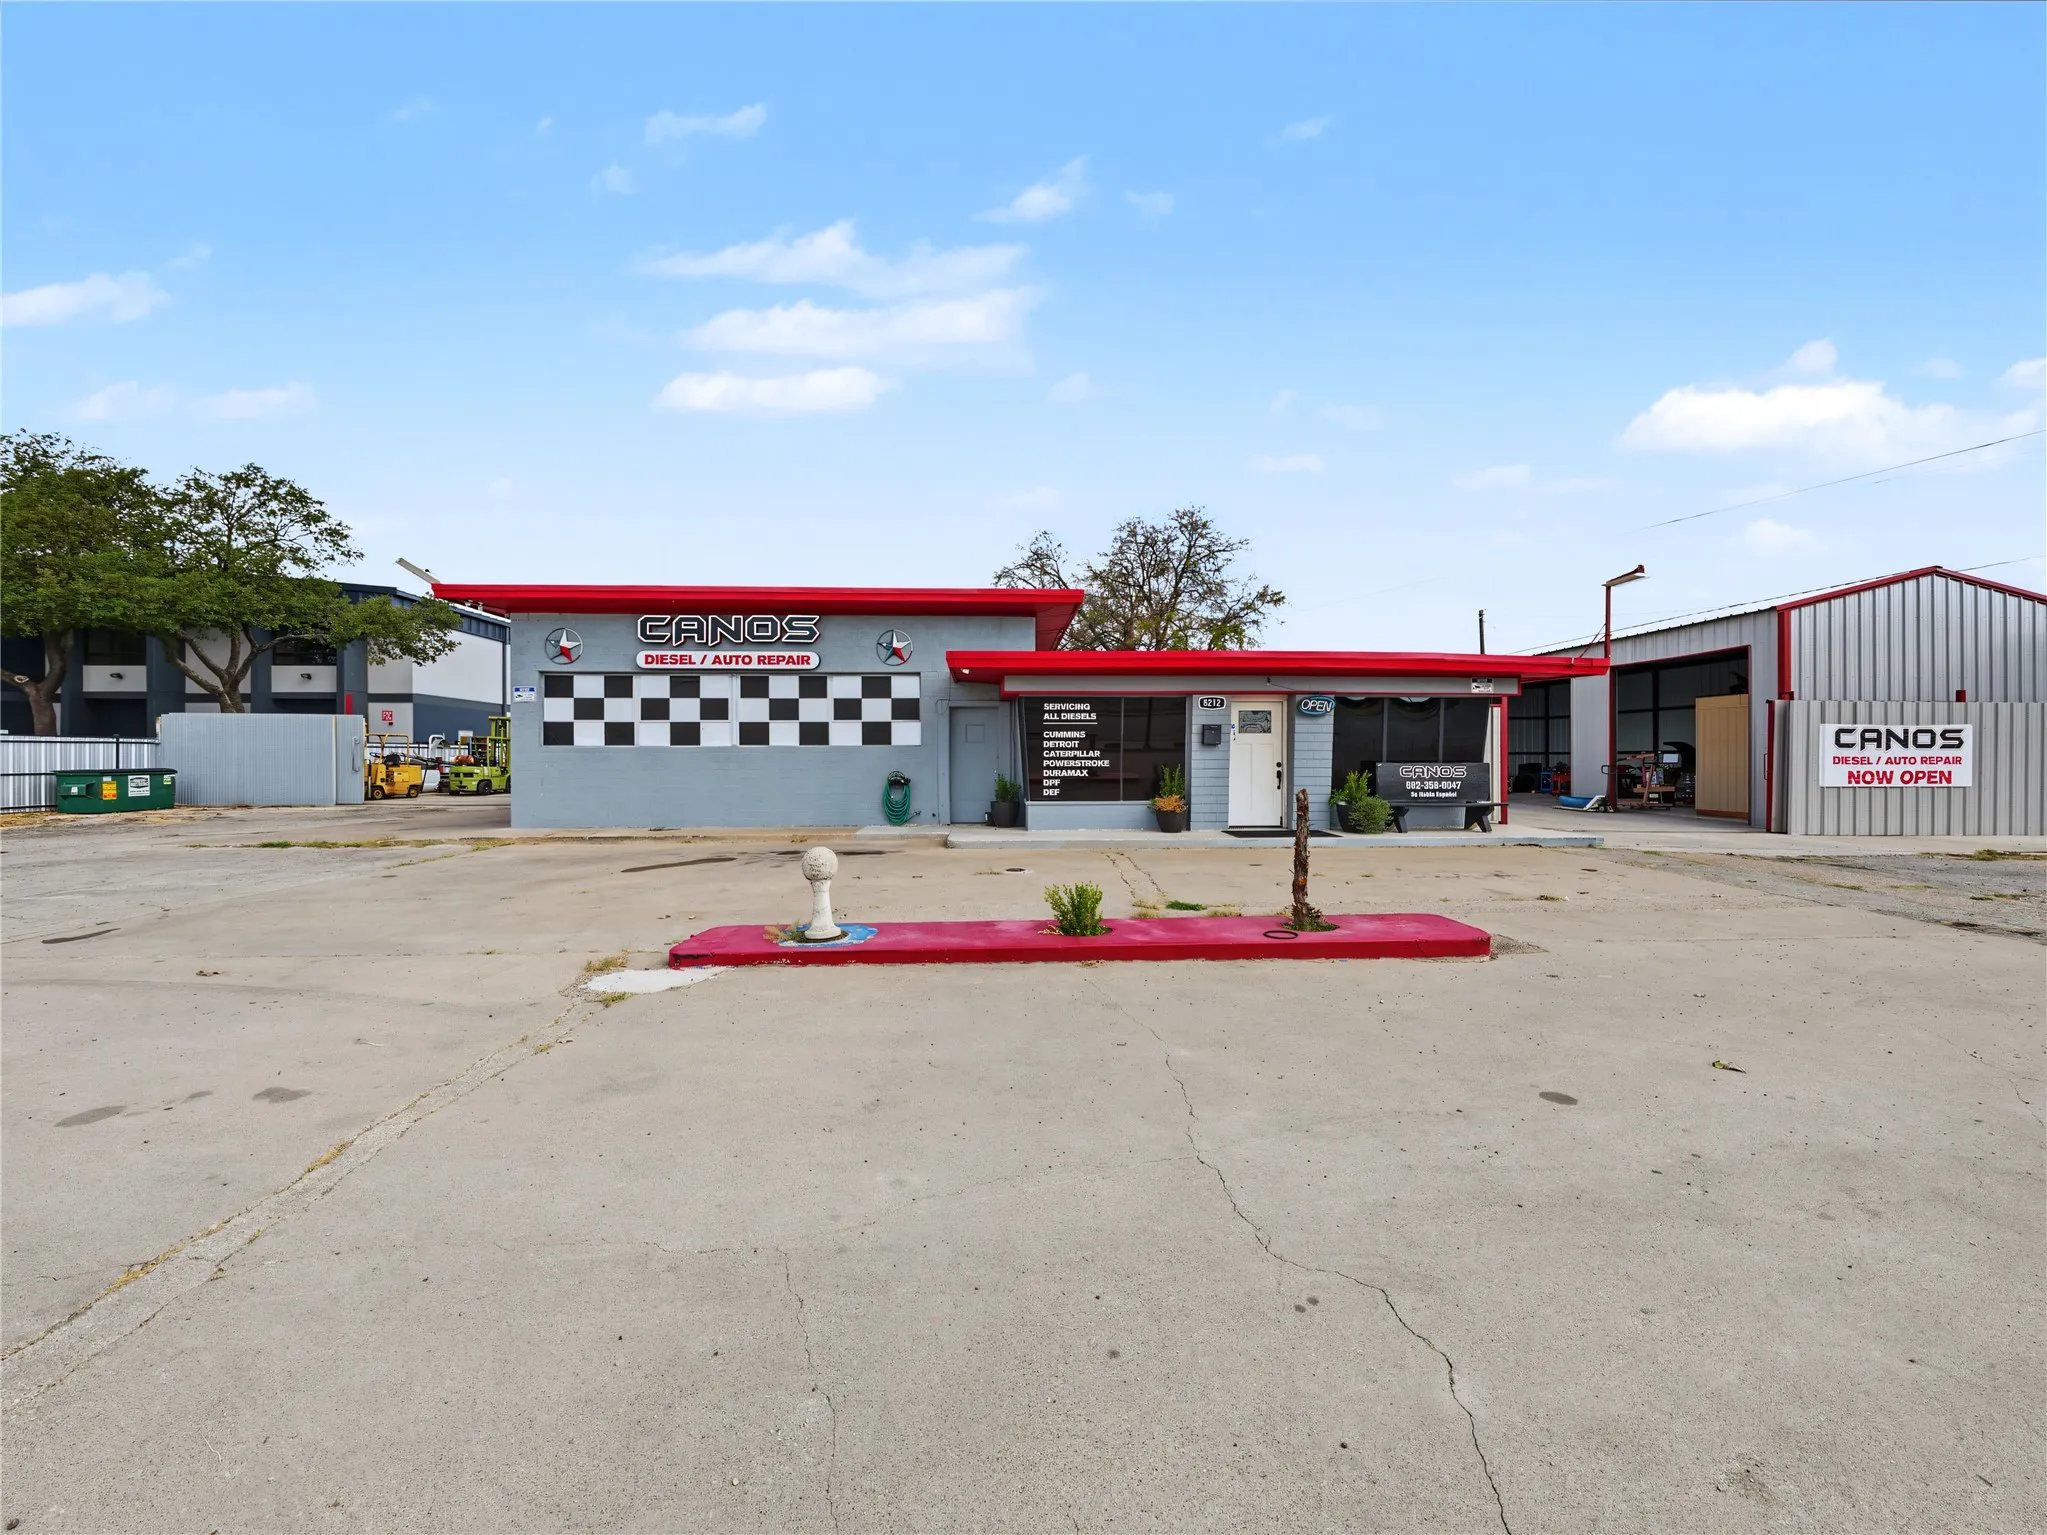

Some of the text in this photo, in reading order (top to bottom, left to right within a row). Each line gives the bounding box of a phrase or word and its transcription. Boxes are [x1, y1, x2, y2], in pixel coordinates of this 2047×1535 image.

[637, 615, 820, 647] CANOS
[644, 654, 811, 665] DIESEL / AUTO REPAIR
[1043, 703, 1091, 711] SERVICING
[1203, 699, 1221, 707] 6212
[1301, 699, 1333, 712] OPEN
[1834, 728, 1965, 752] CANOS
[1832, 756, 1962, 765] DIESEL / AUTO REPAIR
[1400, 765, 1467, 779] CANOS
[1847, 770, 1952, 784] NOW OPEN
